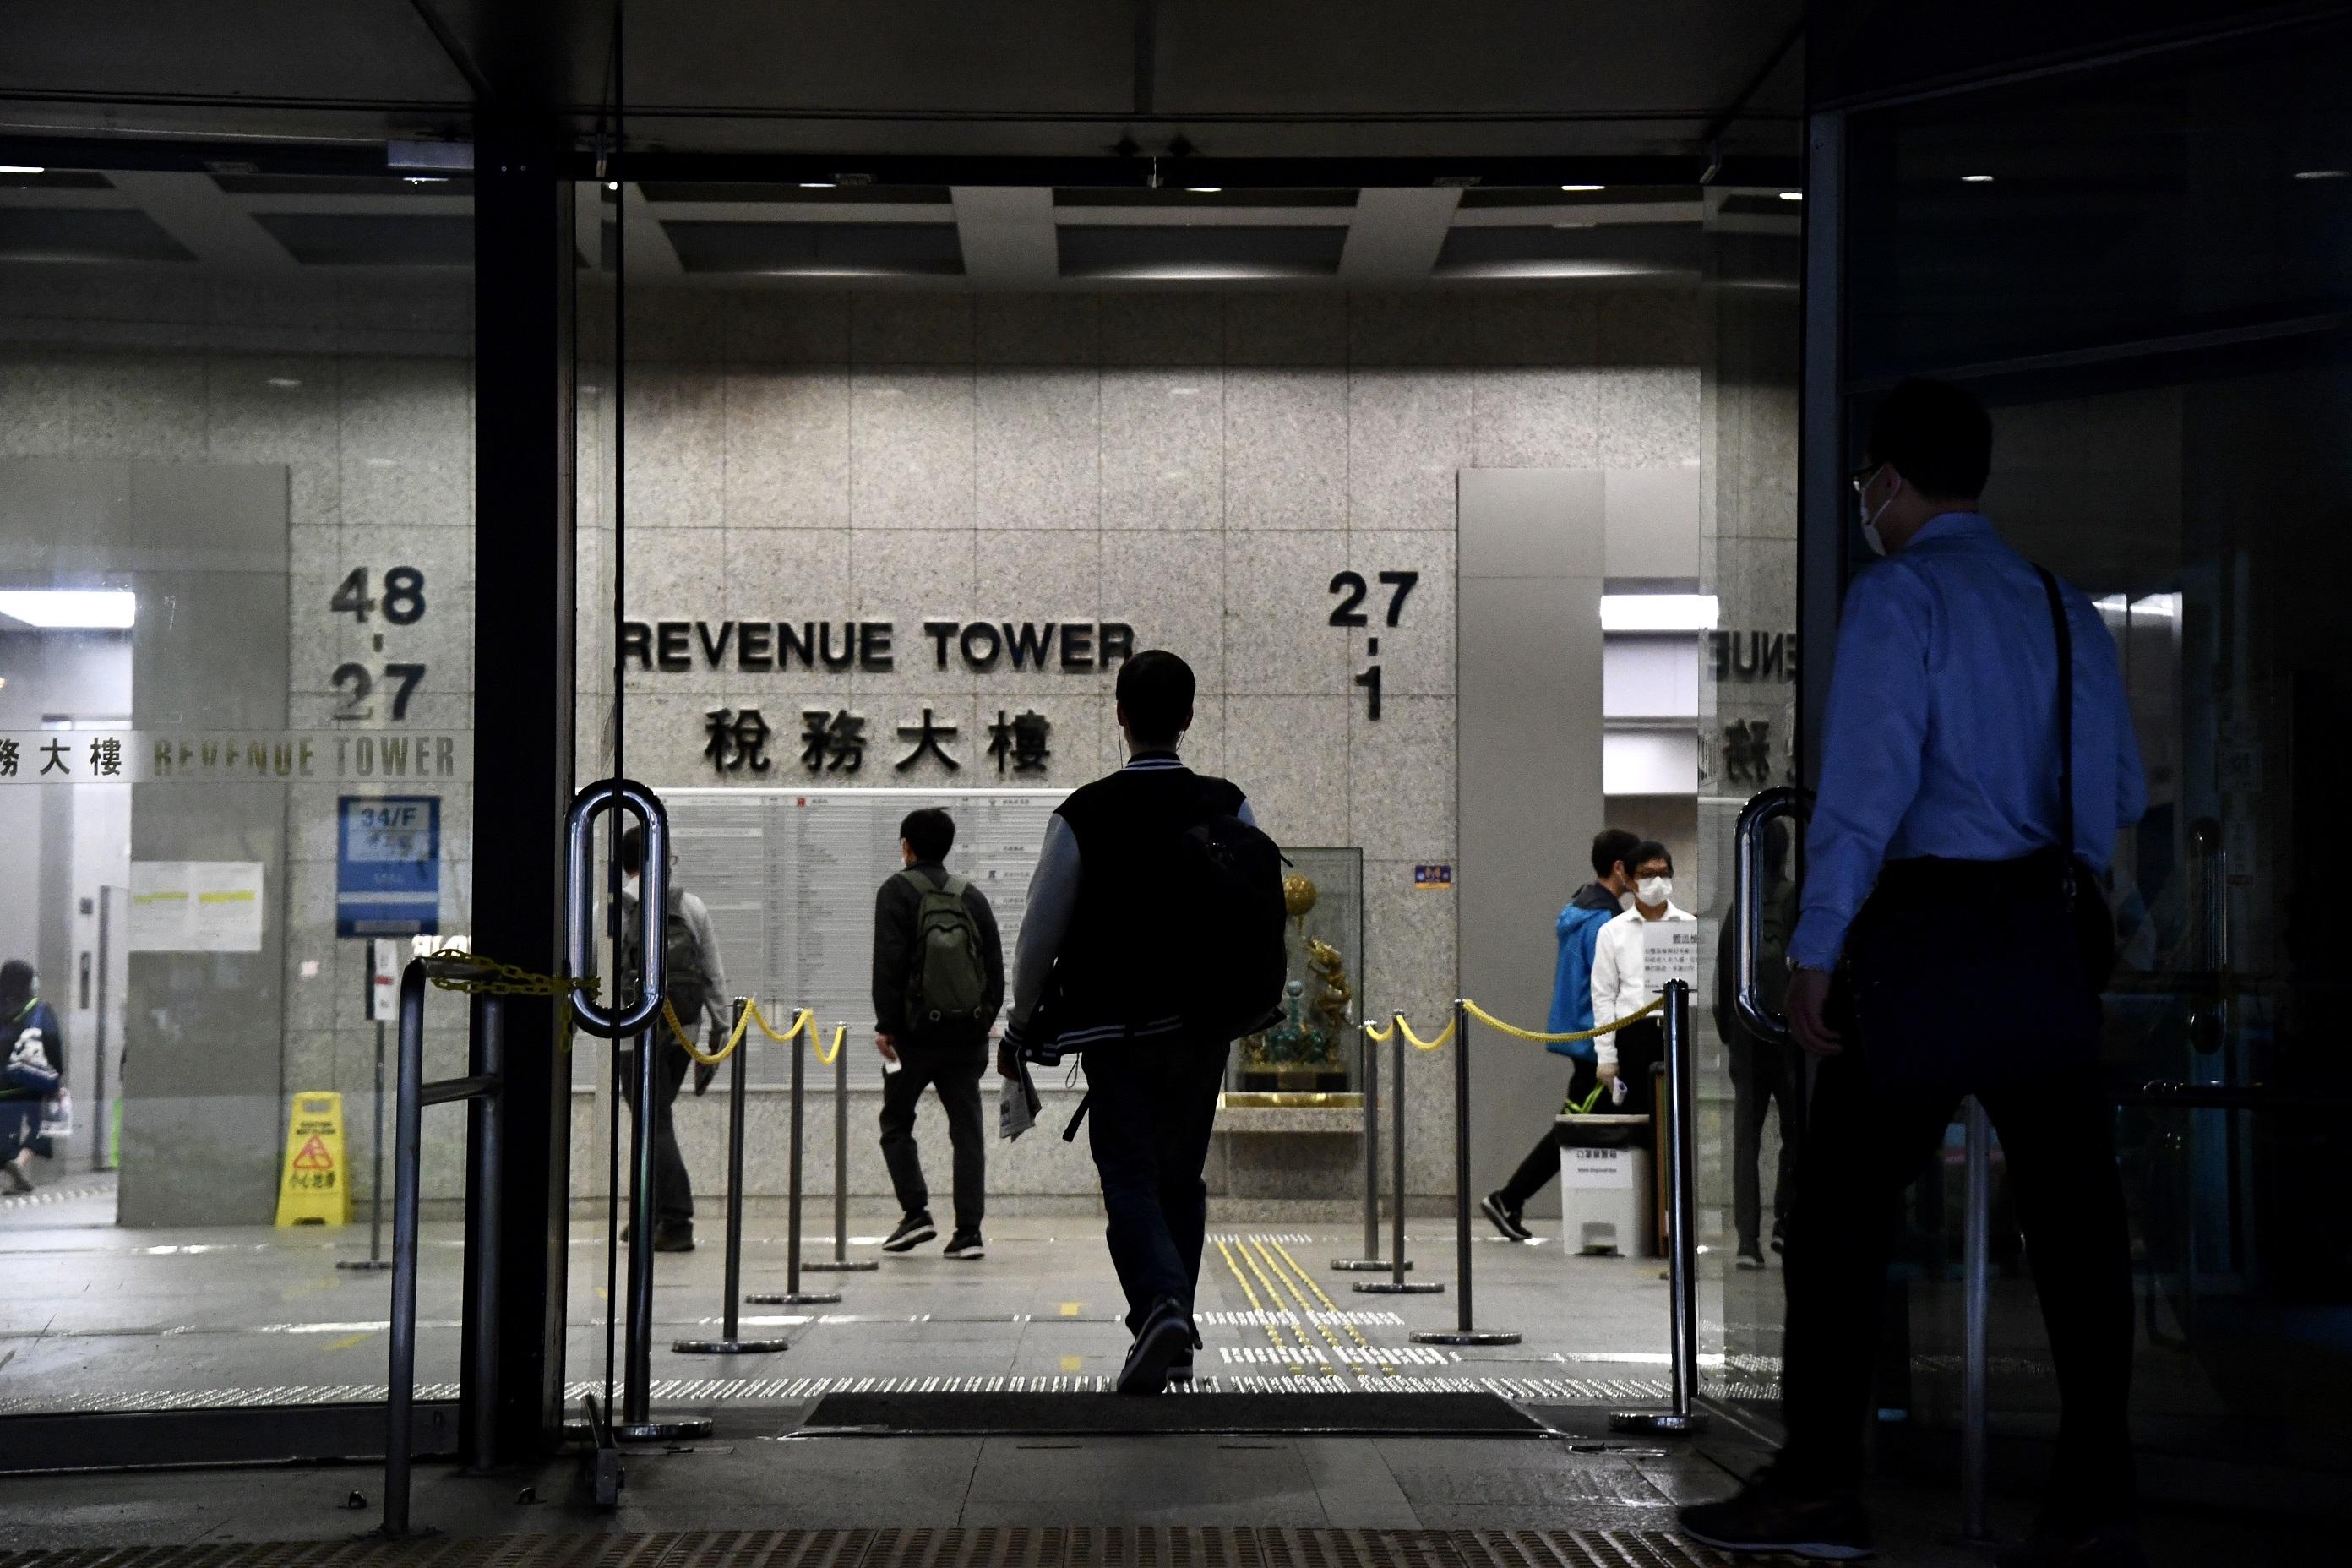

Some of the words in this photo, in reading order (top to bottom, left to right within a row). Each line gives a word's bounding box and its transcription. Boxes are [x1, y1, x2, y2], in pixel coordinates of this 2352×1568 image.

[330, 565, 427, 626] 48
[1328, 570, 1418, 628] 27
[623, 621, 894, 672] REVENUE
[923, 621, 1135, 674] TOWER
[330, 662, 427, 721] 27
[1355, 665, 1381, 721] 1
[0, 737, 122, 776] 務大樓
[333, 736, 455, 776] TOWER
